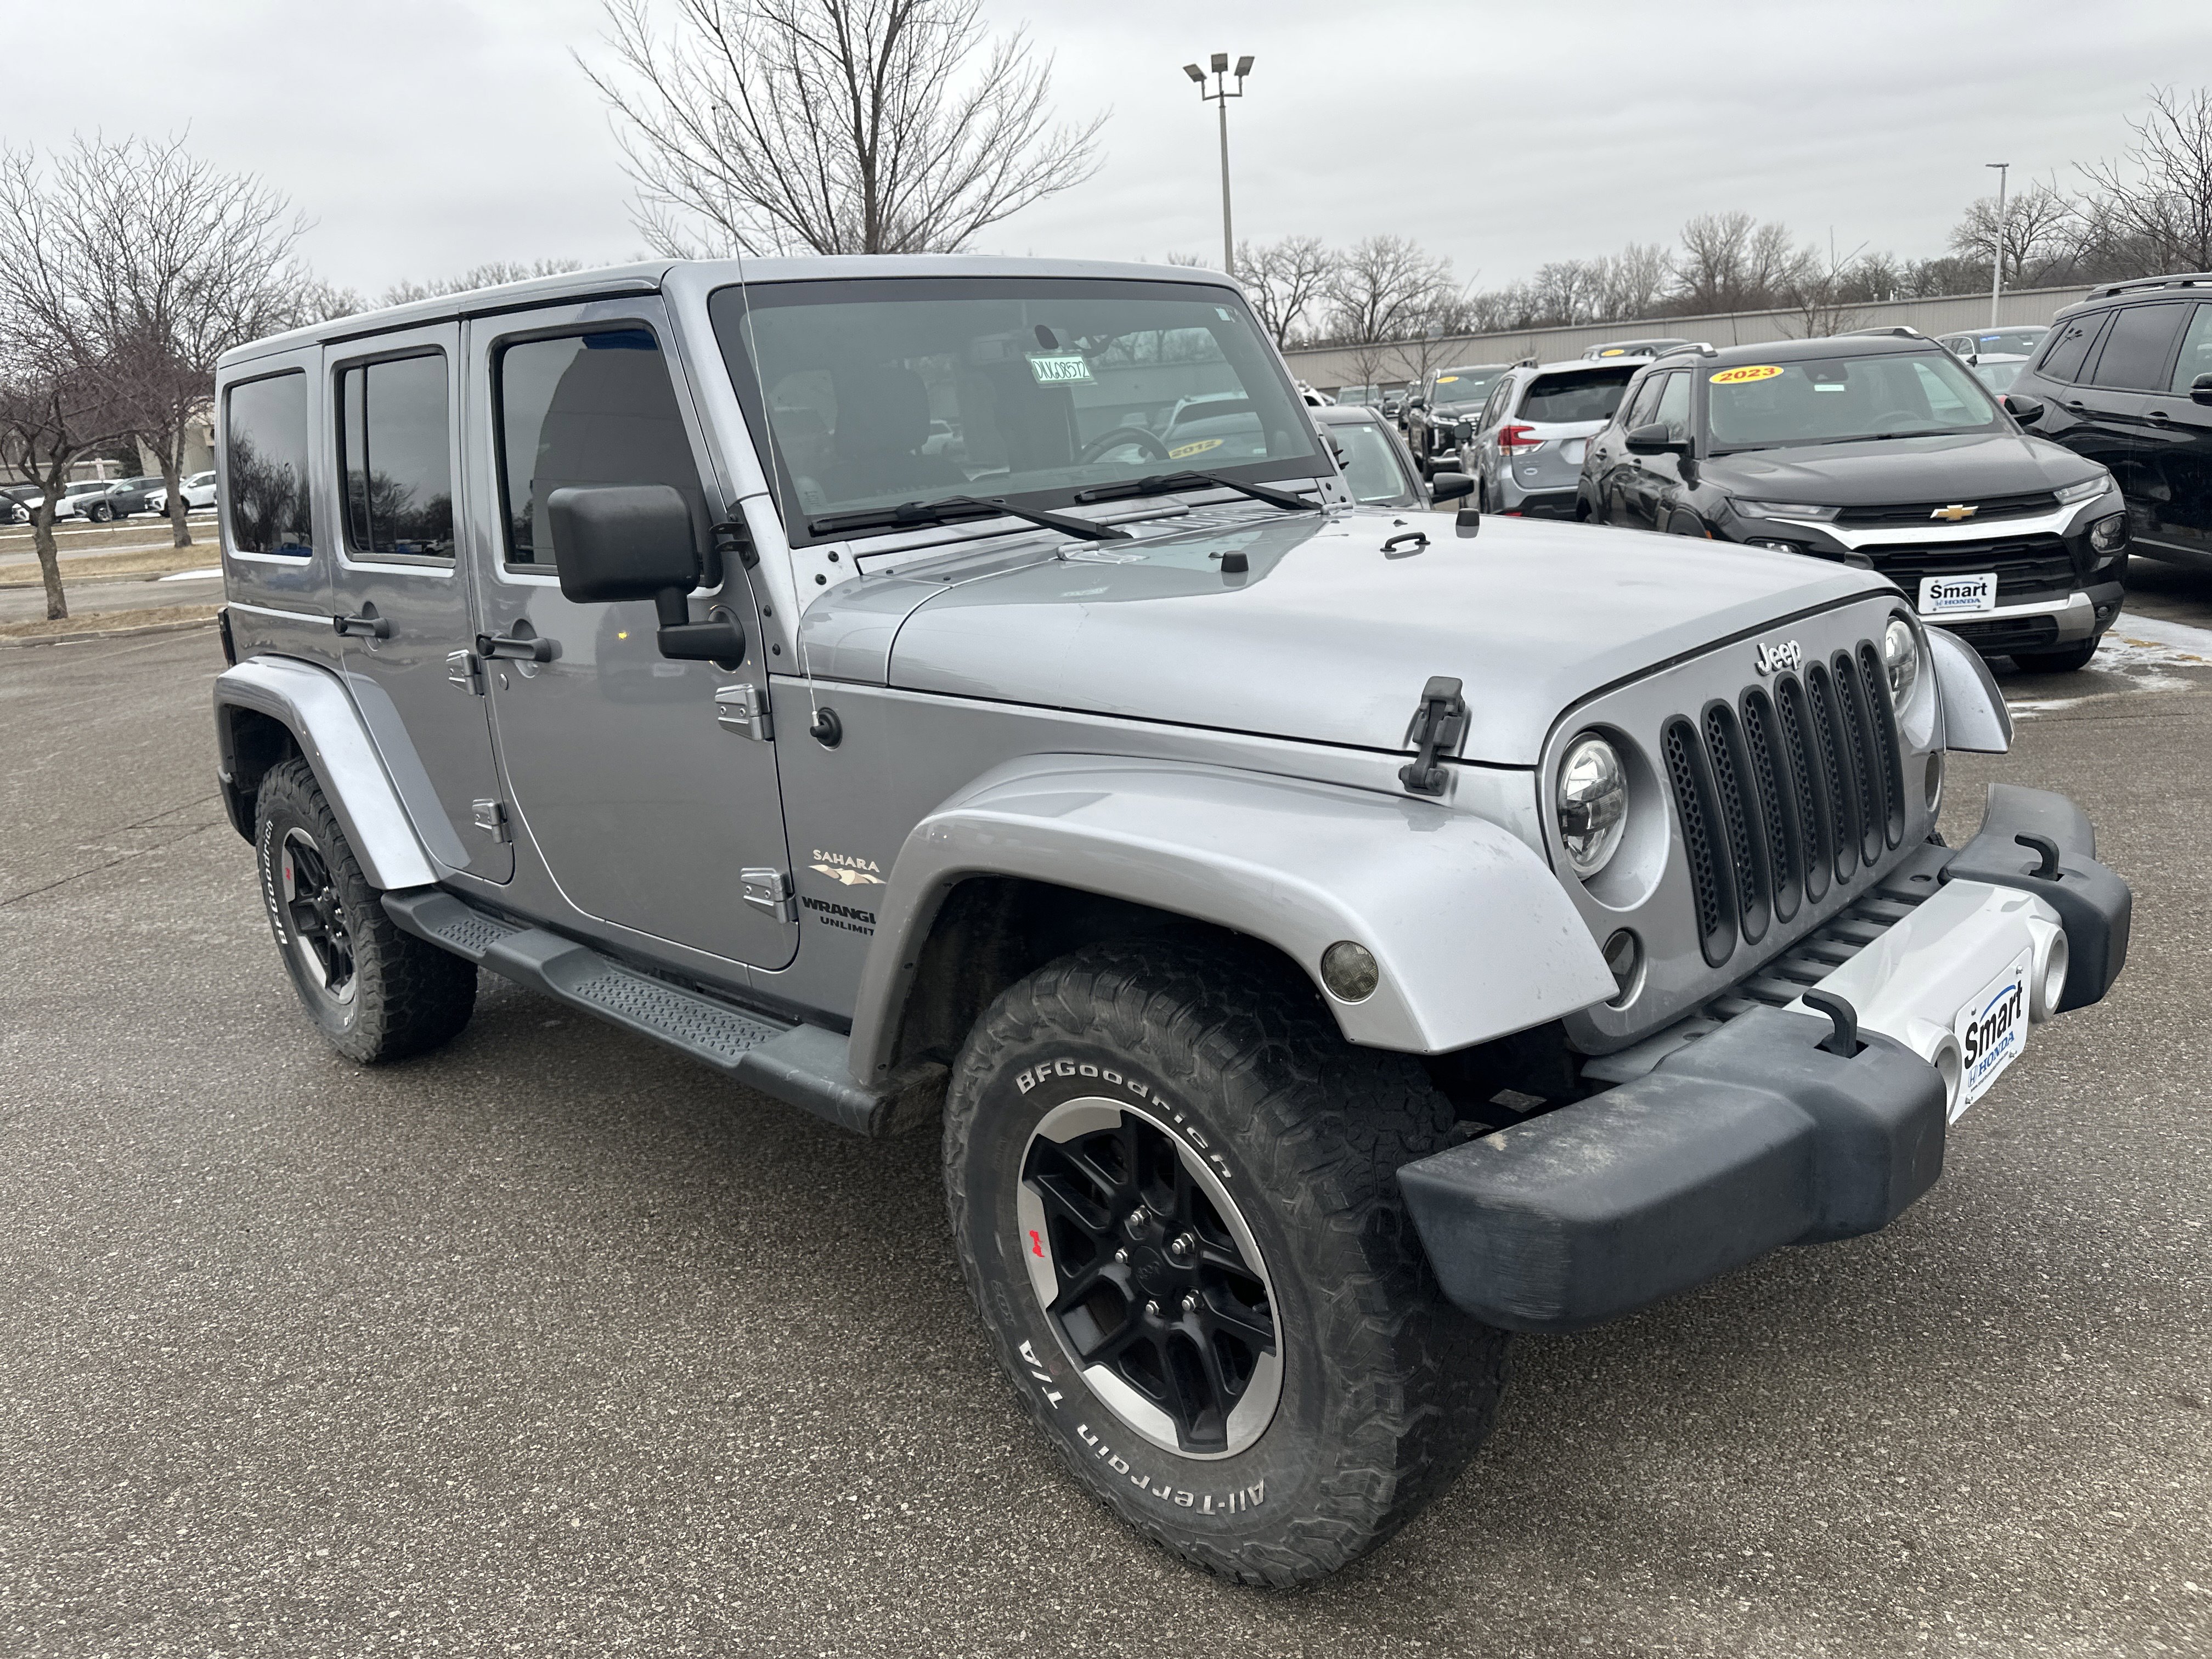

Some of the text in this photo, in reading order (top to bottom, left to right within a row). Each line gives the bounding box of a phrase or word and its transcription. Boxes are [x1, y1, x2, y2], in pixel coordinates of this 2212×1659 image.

[1719, 368, 1775, 382] 2023
[1930, 583, 1988, 599] Smart
[1756, 640, 1802, 676] Jeep
[813, 849, 880, 873] SAHARA
[264, 820, 288, 945] BFGoodrich
[802, 896, 876, 924] WRANGL
[820, 916, 874, 936] UNLIMIT
[1964, 980, 2023, 1070] Smart
[1978, 1030, 2015, 1077] HONDA
[1015, 1059, 1232, 1178] BFGoodrich
[1019, 1340, 1064, 1410] T/A
[1077, 1424, 1265, 1516] All-Terrain
